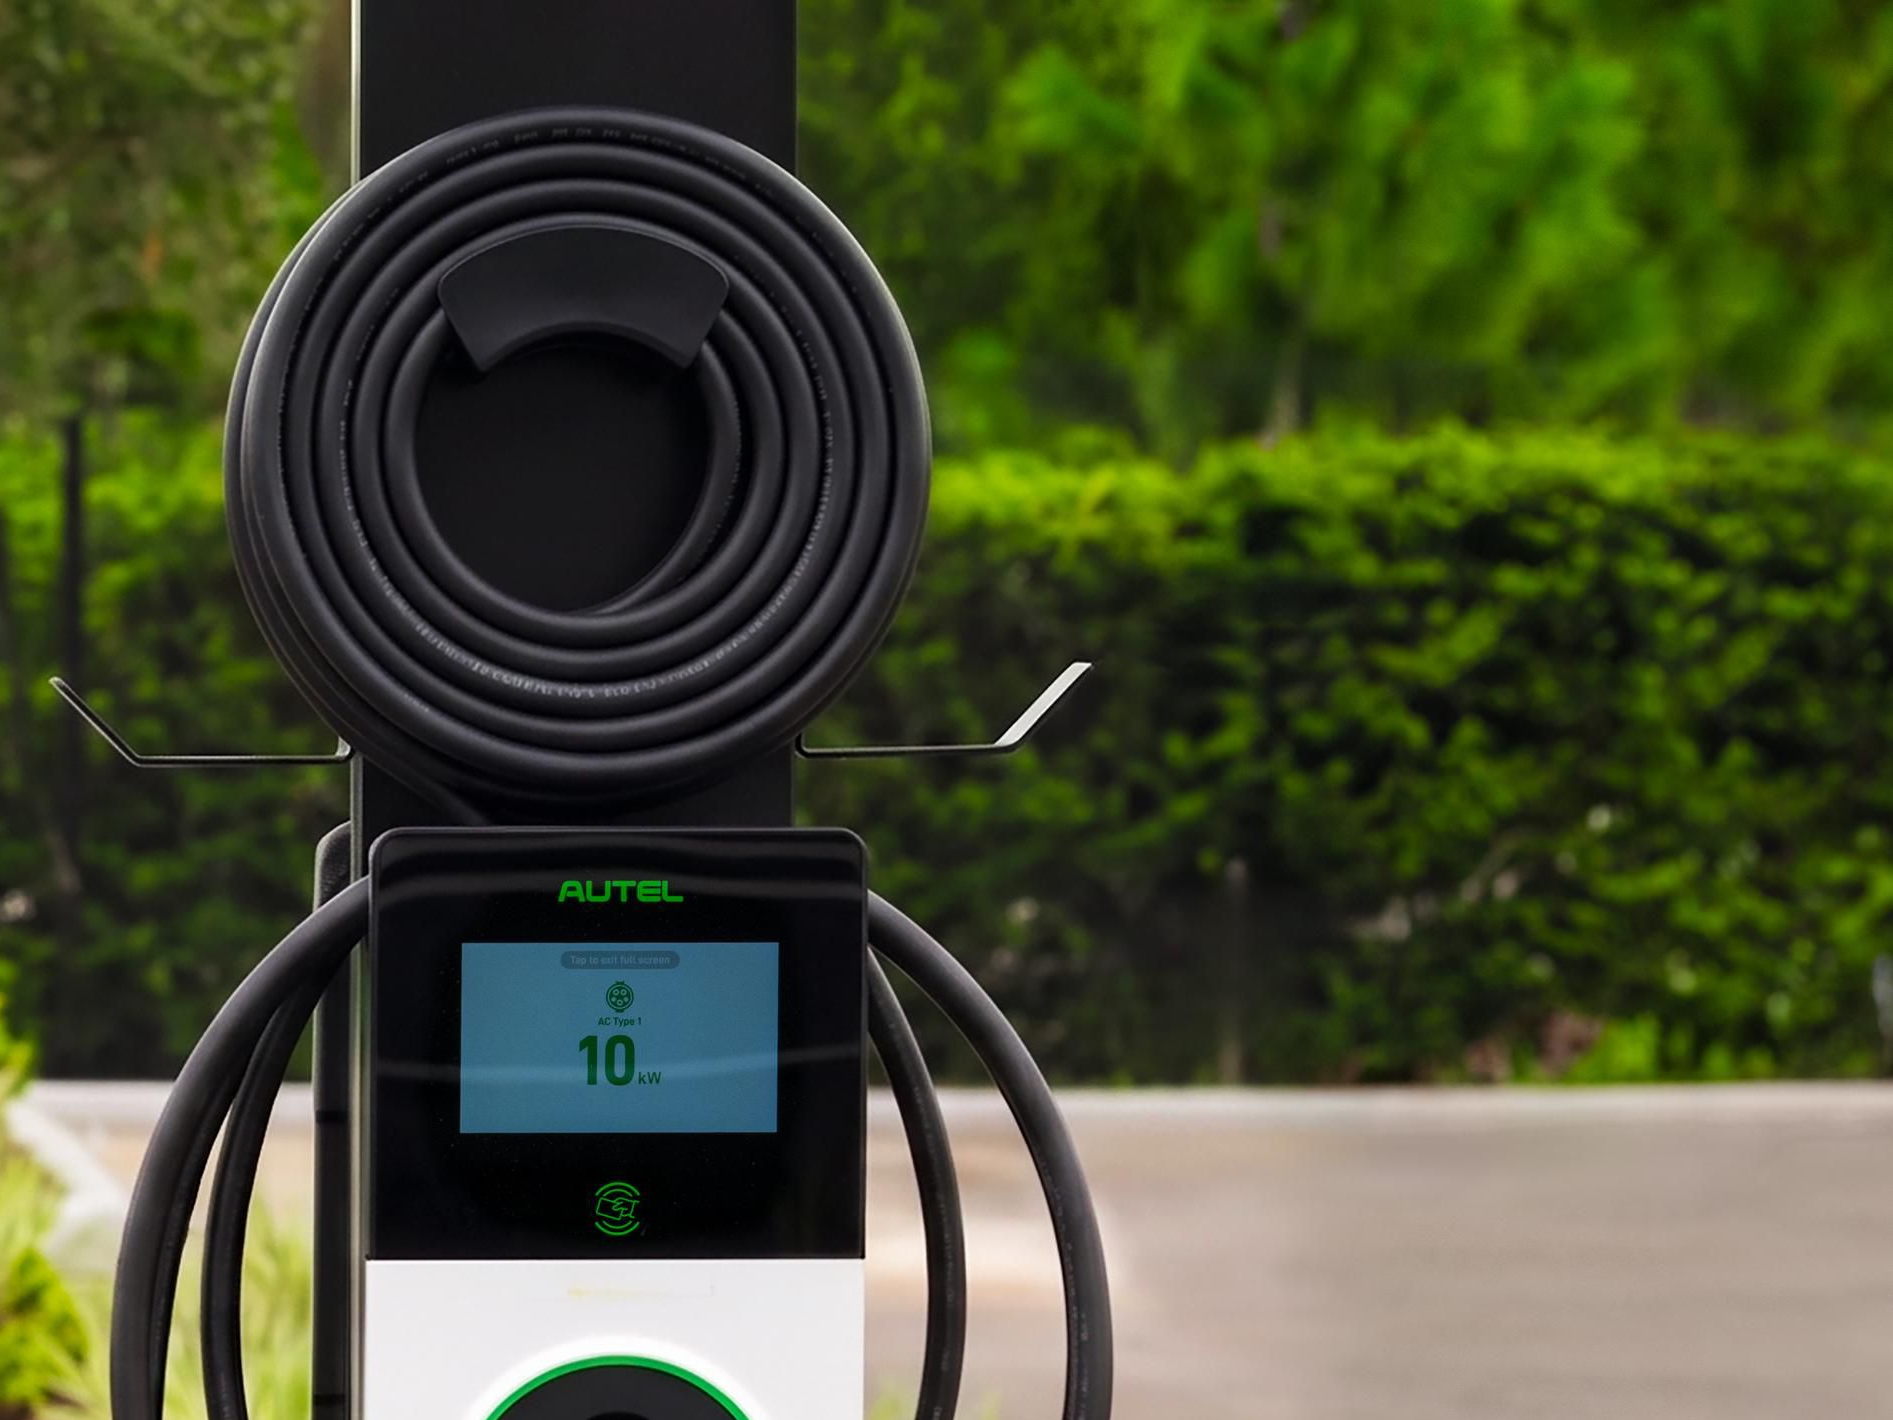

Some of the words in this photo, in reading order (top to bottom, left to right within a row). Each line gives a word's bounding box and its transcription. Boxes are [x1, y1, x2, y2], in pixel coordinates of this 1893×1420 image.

[558, 880, 683, 902] AUTEL
[570, 955, 586, 966] Tap
[589, 955, 598, 965] to
[601, 955, 617, 965] exit
[620, 955, 636, 965] full
[639, 955, 671, 965] screen
[598, 1017, 611, 1025] AC
[613, 1017, 635, 1027] Type
[579, 1035, 635, 1086] 10
[638, 1072, 661, 1084] kW
